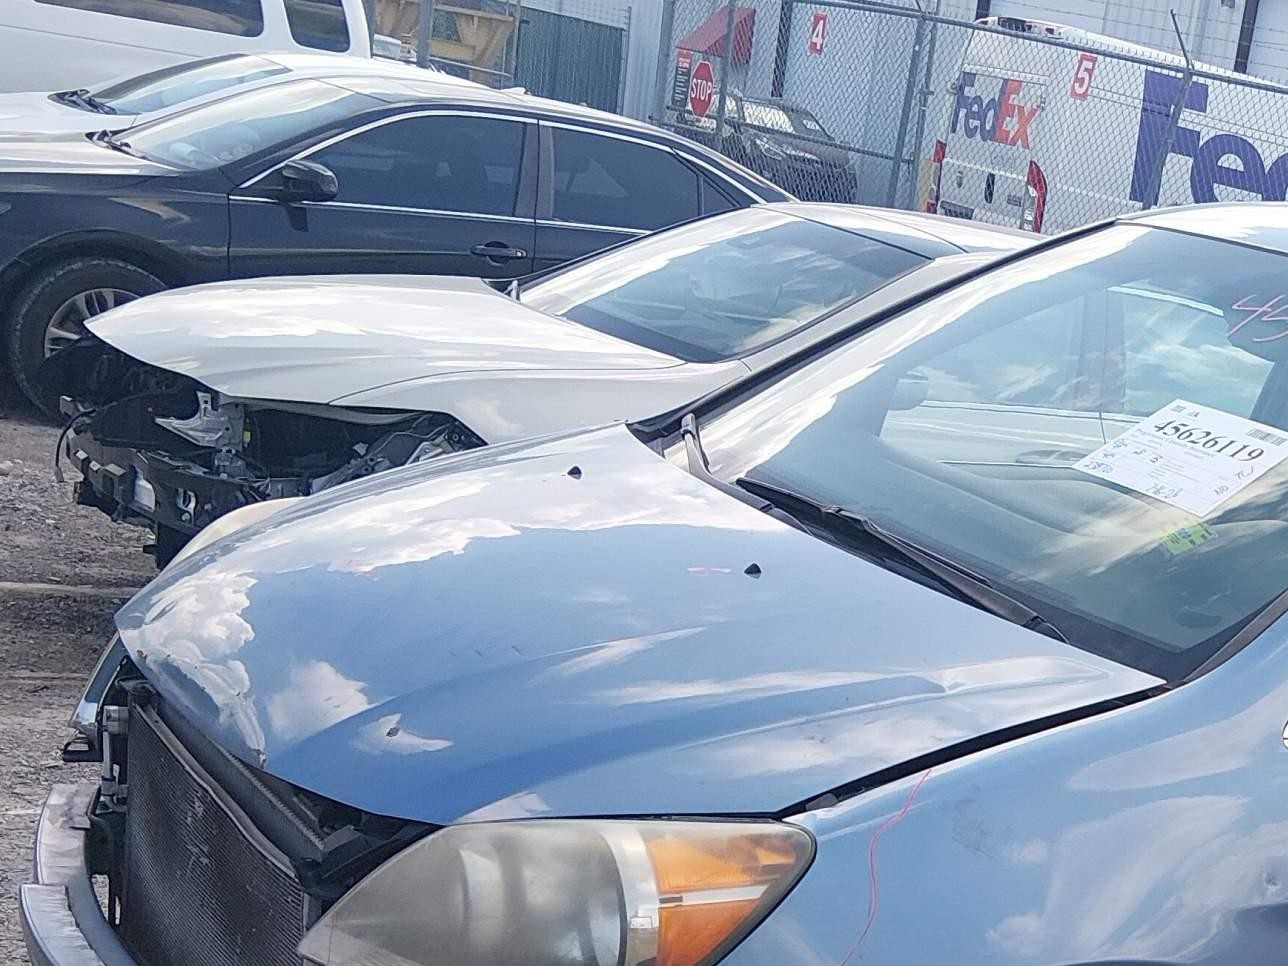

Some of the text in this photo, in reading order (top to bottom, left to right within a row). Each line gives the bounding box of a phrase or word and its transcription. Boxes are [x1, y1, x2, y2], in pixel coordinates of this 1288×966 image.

[811, 19, 824, 50] 4
[690, 78, 713, 101] STOP
[1073, 60, 1093, 95] 5
[951, 72, 1041, 149] FedEx
[1153, 419, 1265, 462] 45626119
